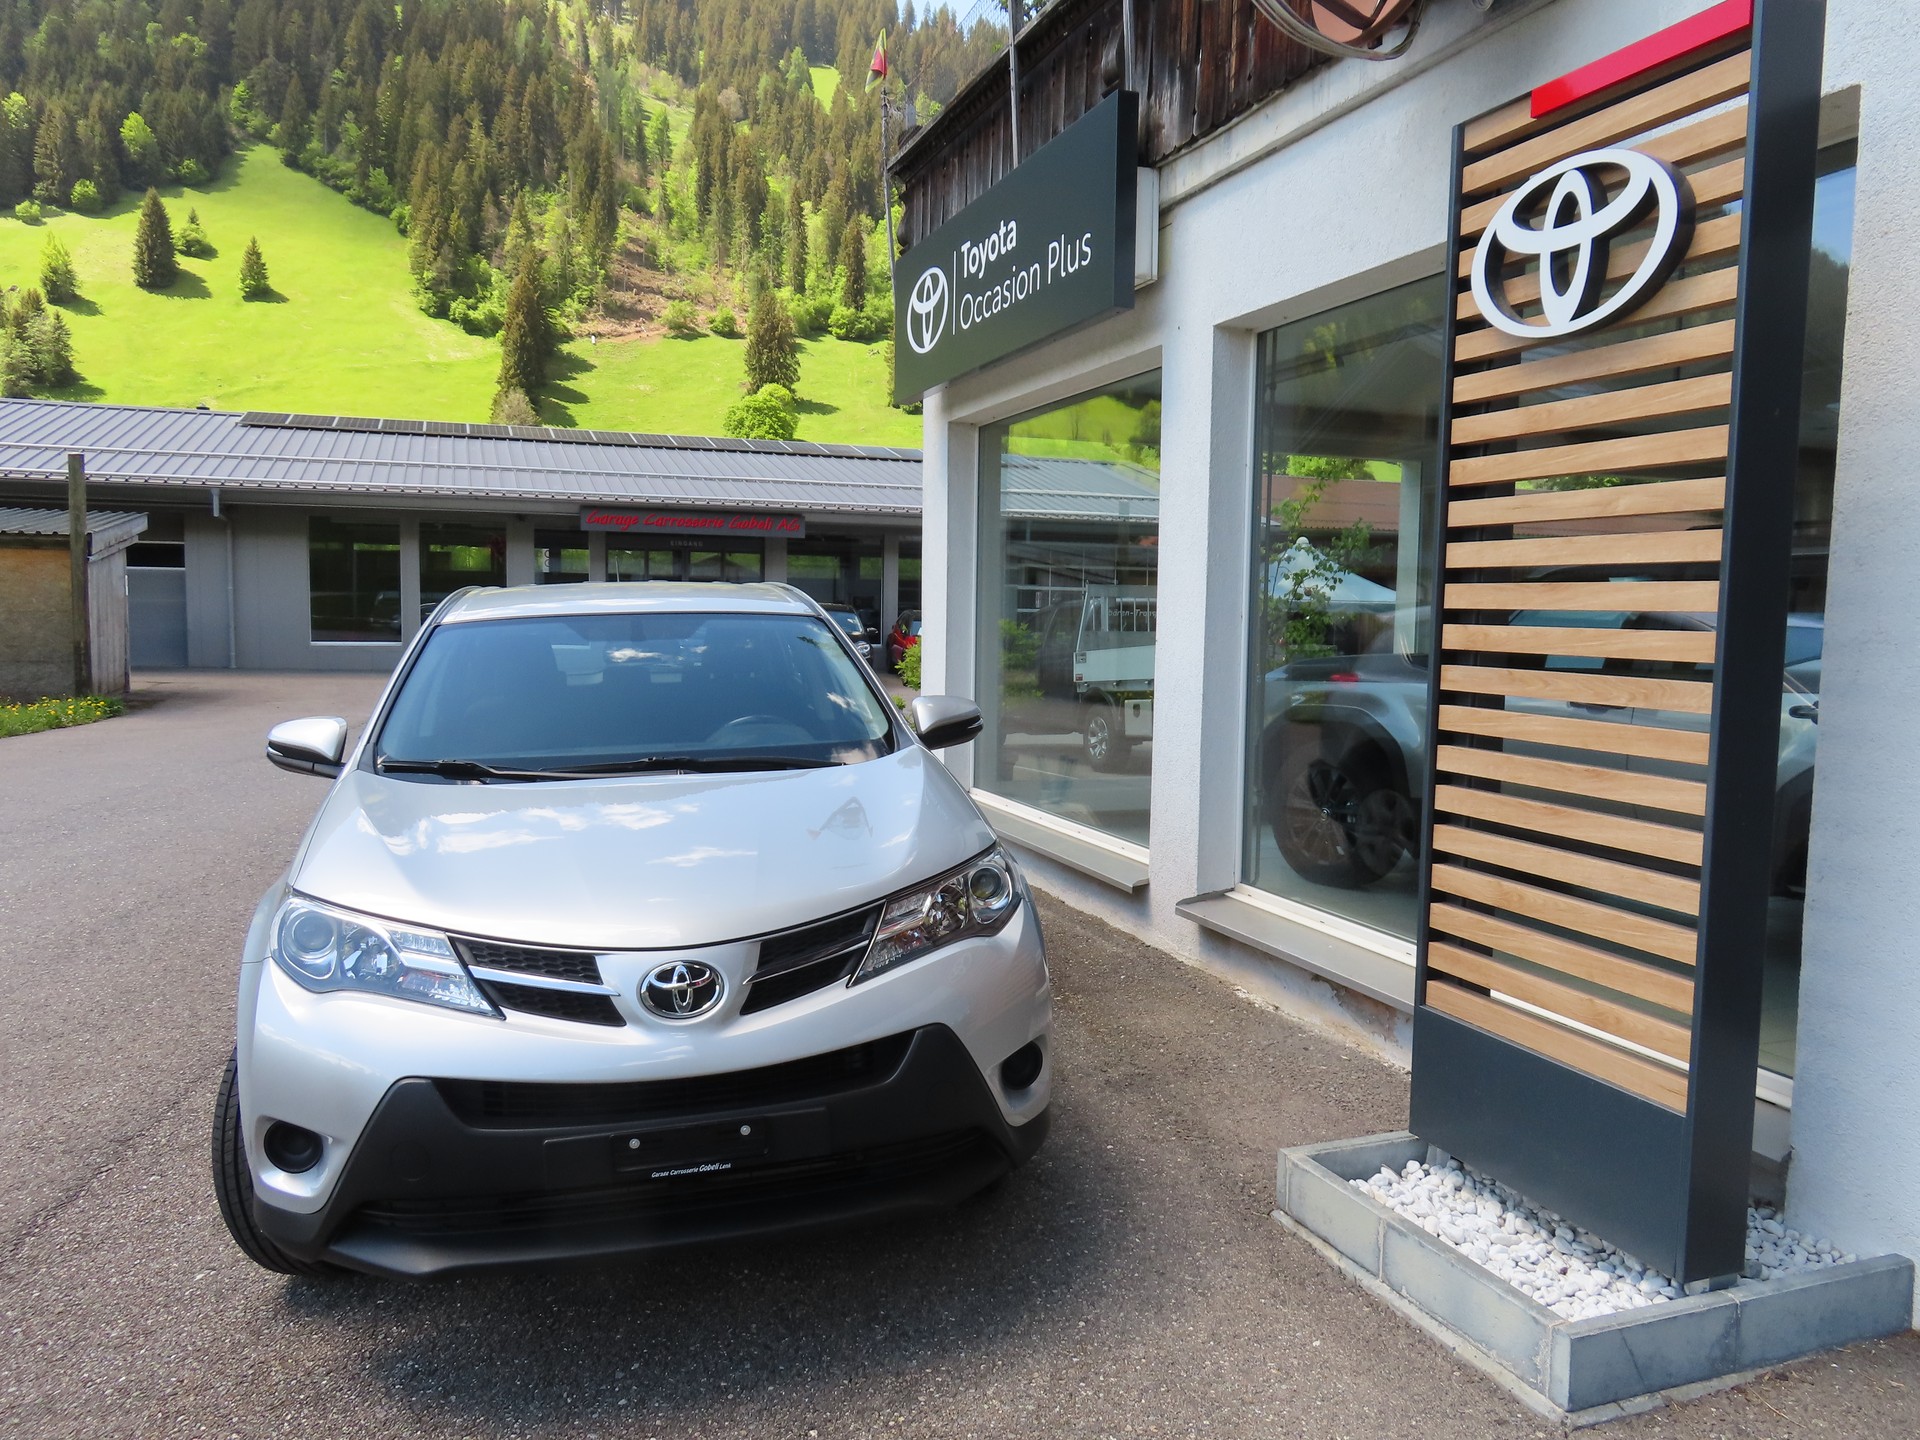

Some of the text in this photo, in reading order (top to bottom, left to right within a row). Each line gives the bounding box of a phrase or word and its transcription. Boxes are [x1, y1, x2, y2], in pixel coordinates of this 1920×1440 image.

[961, 220, 1017, 279] Toyota
[960, 232, 1092, 330] Occasion Plus
[586, 510, 800, 531] Garage Carrosserie Gobeli AG
